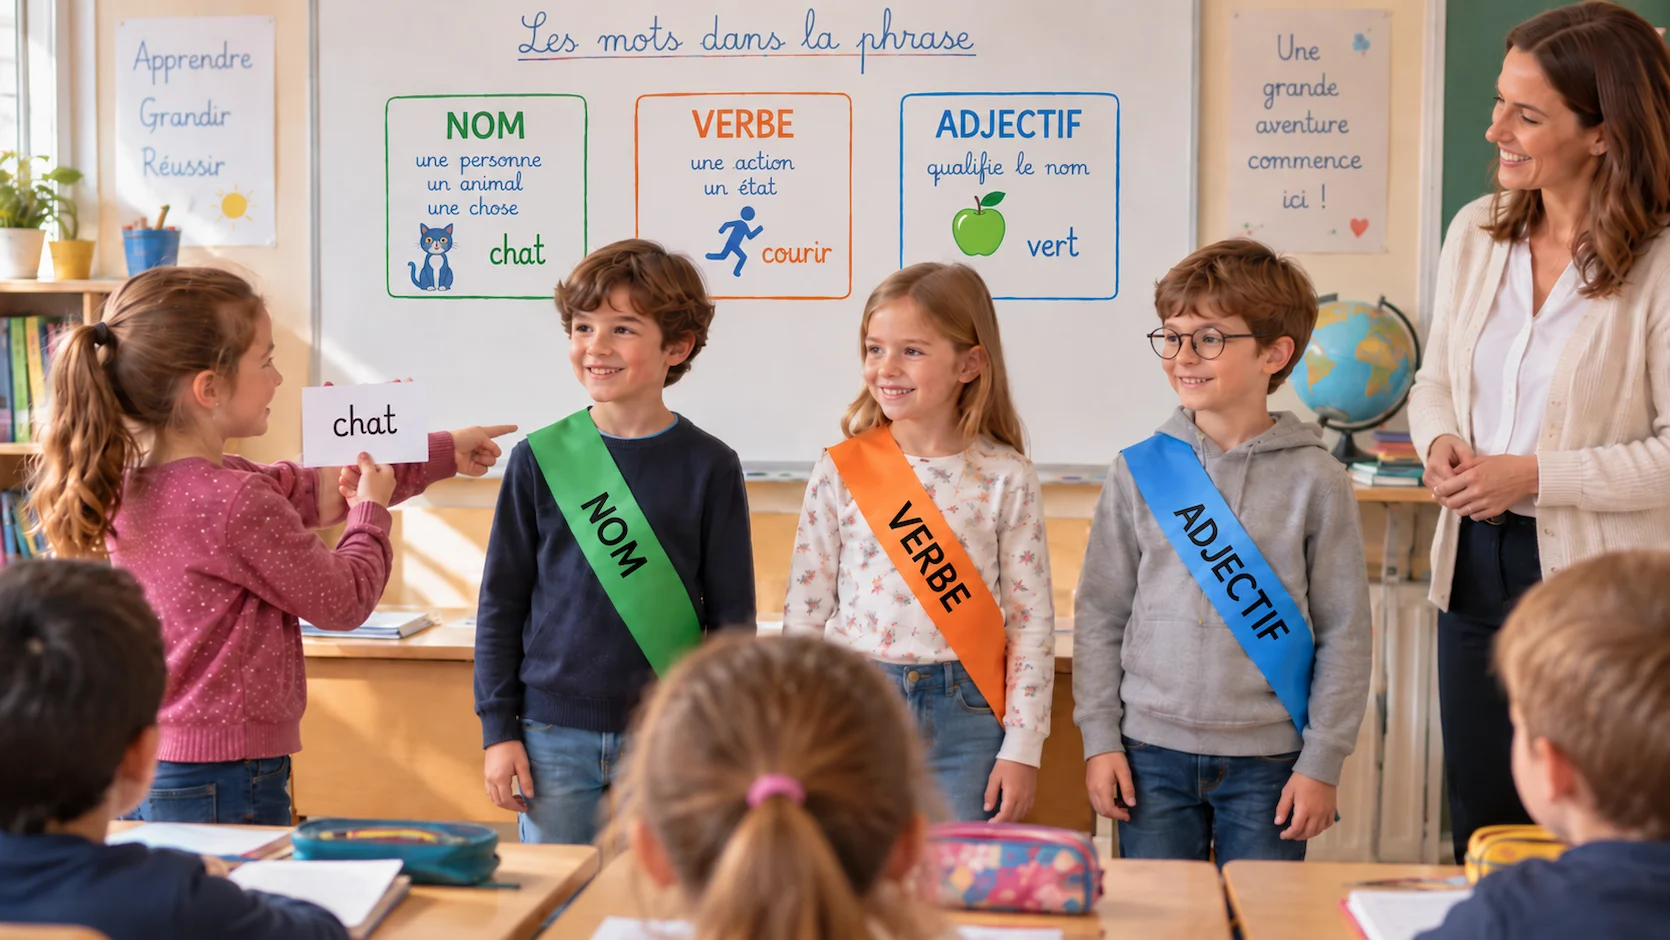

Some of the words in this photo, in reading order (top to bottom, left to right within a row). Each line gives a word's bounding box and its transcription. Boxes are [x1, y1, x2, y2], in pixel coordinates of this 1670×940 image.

[517, 10, 578, 54] Les
[597, 15, 684, 53] mots
[699, 14, 787, 51] dans
[800, 7, 841, 50] la
[856, 7, 975, 75] phrase
[1277, 33, 1321, 62] Une
[132, 40, 254, 85] Apprendre
[1262, 72, 1340, 110] grande
[139, 97, 231, 133] Grandir
[446, 110, 525, 140] NOM
[691, 108, 795, 139] VERBE
[935, 108, 1083, 140] ADJECTIF
[1255, 109, 1350, 135] aventure
[142, 146, 226, 177] Réussir
[415, 155, 449, 168] une
[459, 154, 543, 175] personne
[690, 158, 725, 171] une
[735, 150, 796, 171] action
[926, 150, 1005, 188] qualifie
[1015, 150, 1035, 176] le
[1044, 163, 1091, 176] nom
[1247, 154, 1363, 170] commence
[427, 179, 452, 192] un
[459, 171, 524, 192] animal
[704, 184, 729, 196] un
[737, 176, 778, 196] état
[1282, 190, 1310, 210] ici
[1319, 183, 1328, 210] !
[427, 203, 460, 216] une
[469, 195, 519, 216] chose
[489, 232, 547, 266] chat
[761, 240, 833, 264] courir
[1026, 226, 1080, 258] vert
[332, 403, 398, 438] chat
[580, 490, 648, 580] NOM
[888, 500, 971, 613] VERBE
[1172, 502, 1291, 642] ADJECTIF
